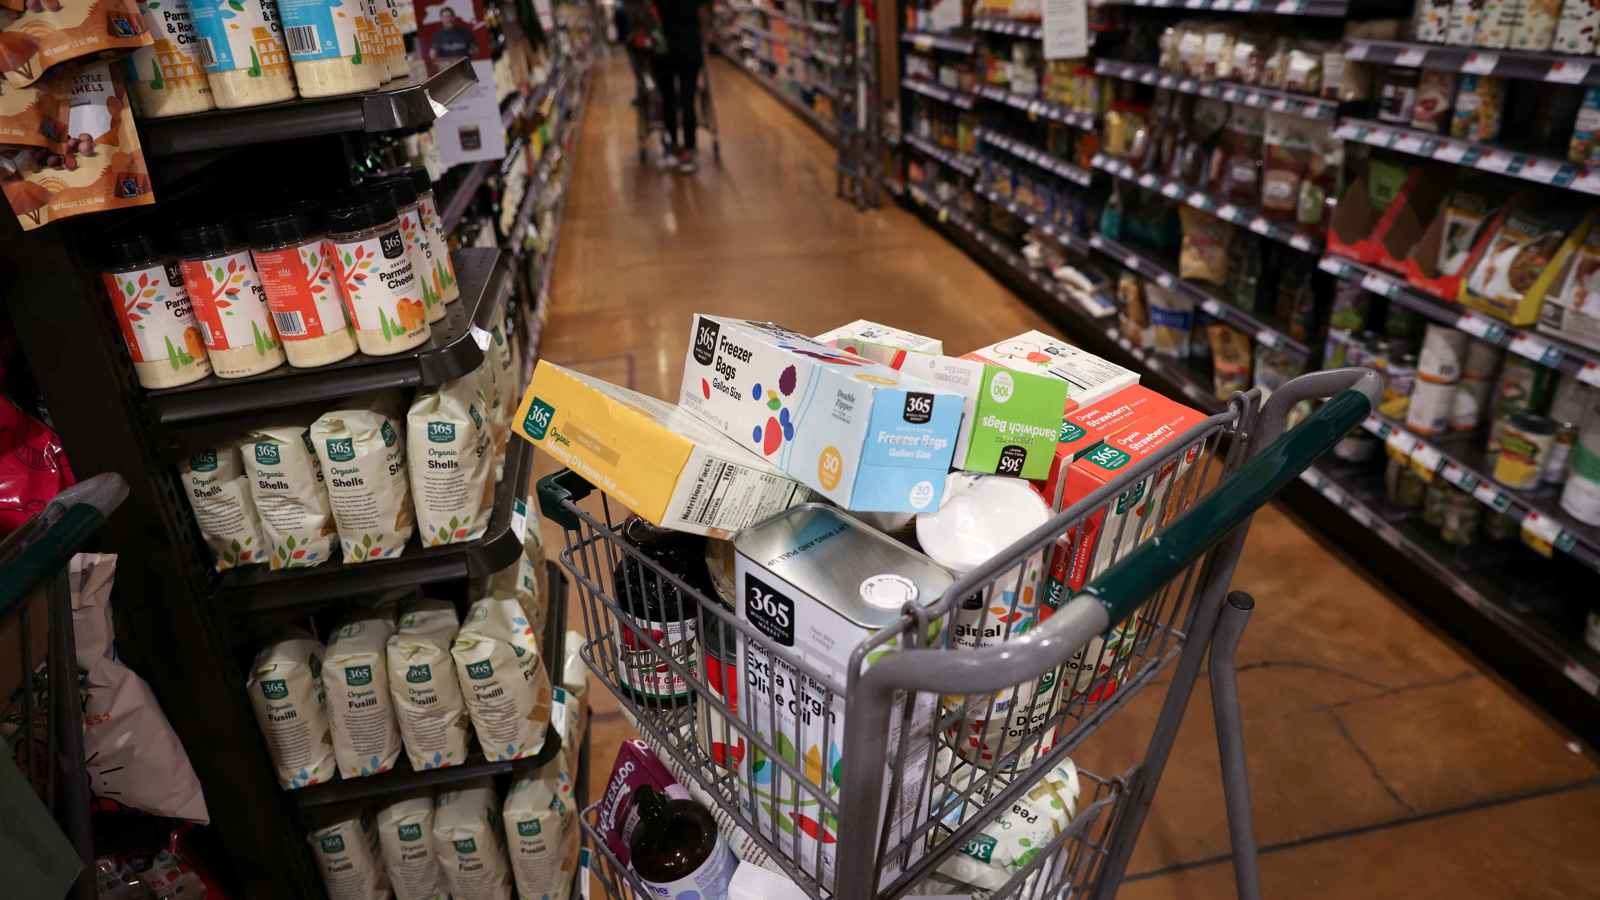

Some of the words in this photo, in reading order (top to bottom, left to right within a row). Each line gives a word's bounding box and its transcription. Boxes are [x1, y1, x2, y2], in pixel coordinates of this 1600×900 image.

[262, 11, 270, 19] &
[167, 23, 176, 33] &
[383, 234, 400, 252] 365
[696, 325, 716, 351] 365
[719, 335, 753, 364] Freezer
[715, 355, 737, 381] Bags
[712, 377, 730, 394] Gallon
[730, 385, 743, 401] Size
[993, 386, 1010, 397] 100
[906, 397, 931, 413] 365
[528, 405, 550, 429] 365
[981, 415, 1008, 433] Bags
[1086, 405, 1131, 428] Strawberry
[430, 422, 453, 436] 365
[550, 426, 570, 447] Organic
[1008, 421, 1057, 442] Sandwich
[878, 431, 919, 447] Freezer
[921, 434, 948, 450] Bags
[1116, 431, 1141, 446] Organic
[1128, 424, 1171, 451] Strawberry
[256, 444, 278, 459] 365
[330, 439, 352, 454] 365
[427, 448, 457, 457] Organic
[822, 452, 839, 472] 30
[1091, 447, 1120, 465] 365
[331, 466, 360, 477] Organic
[427, 458, 459, 470] Shells
[999, 455, 1023, 473] 365
[256, 470, 285, 480] Organic
[258, 480, 290, 491] Shells
[332, 477, 365, 489] Shells
[681, 478, 704, 520] Nutrition
[698, 458, 714, 482] Facts
[192, 484, 224, 499] Shells
[704, 497, 721, 527] Calories
[722, 464, 736, 482] 160
[750, 587, 790, 628] 365
[954, 624, 1001, 639] ginal
[347, 667, 370, 681] 365
[468, 662, 491, 678] 365
[748, 652, 785, 688] Exta
[264, 681, 286, 694] 365
[346, 688, 375, 699] Organic
[407, 687, 435, 697] Organic
[472, 681, 499, 692] Organic
[474, 687, 505, 702] Fusilli
[265, 703, 294, 713] Organic
[347, 697, 379, 709] Fusilli
[267, 710, 298, 722] Fusilli
[1016, 710, 1051, 727] Dced
[1012, 804, 1039, 824] Pea
